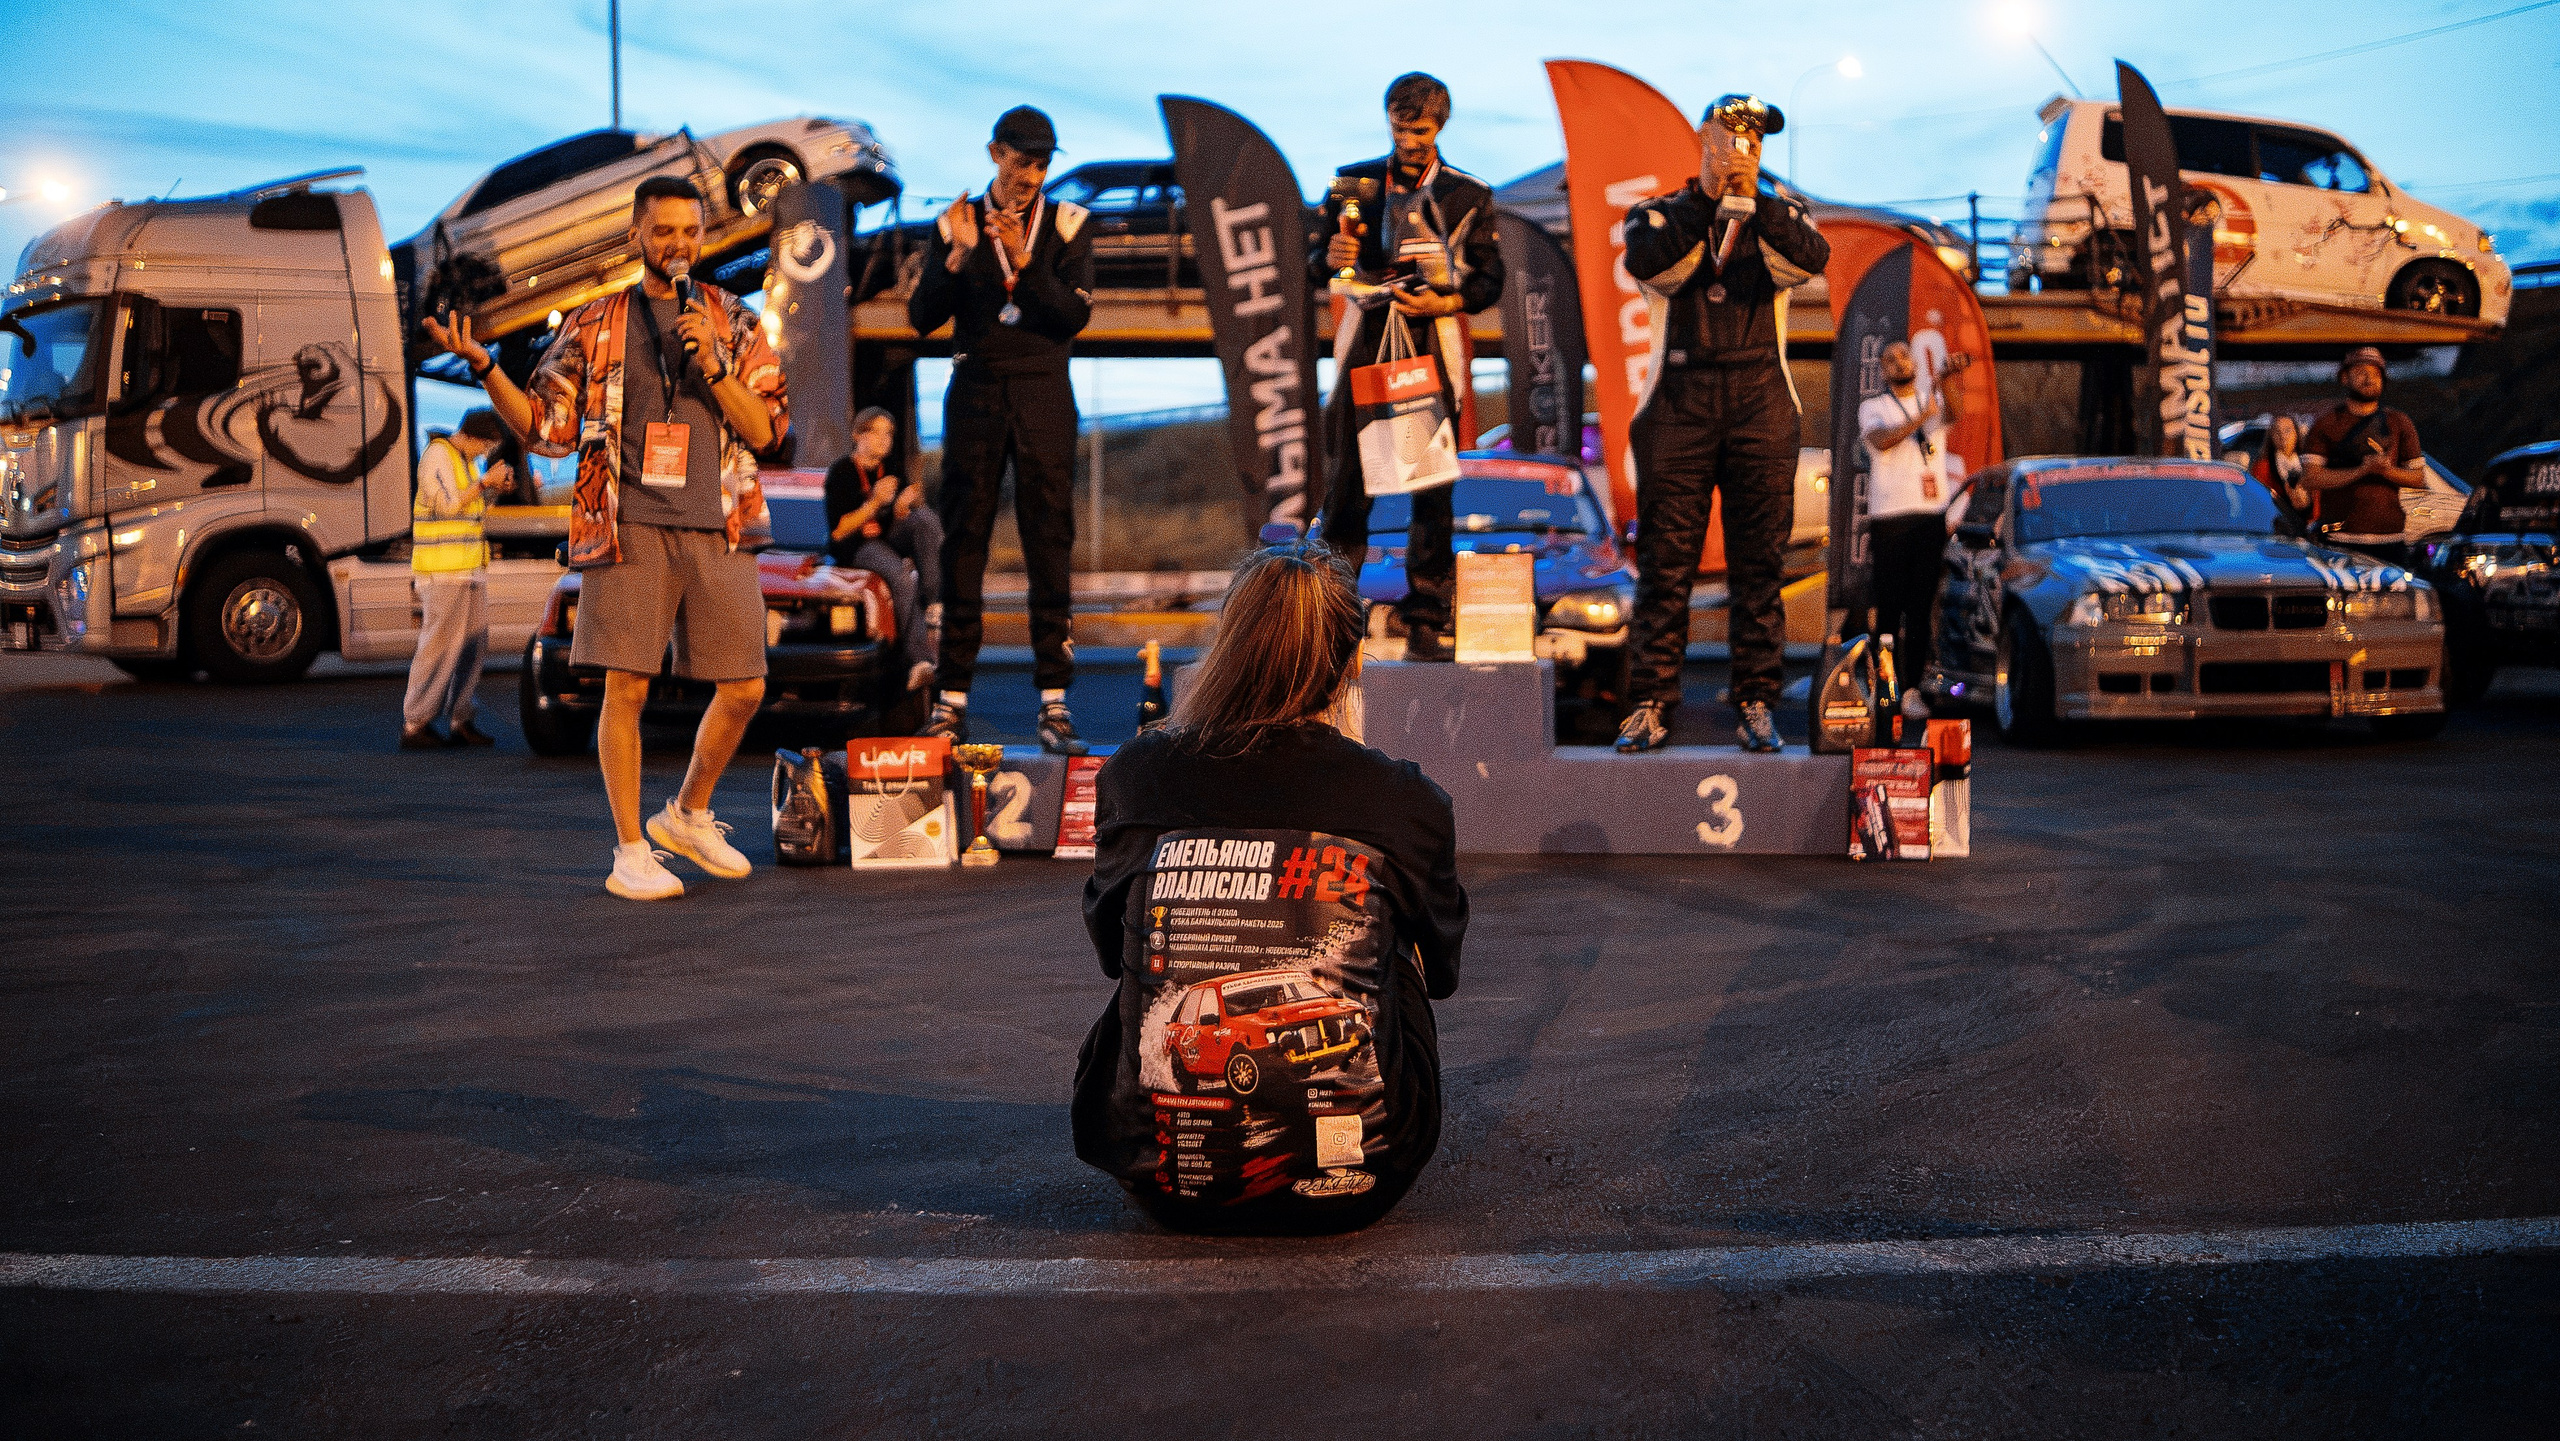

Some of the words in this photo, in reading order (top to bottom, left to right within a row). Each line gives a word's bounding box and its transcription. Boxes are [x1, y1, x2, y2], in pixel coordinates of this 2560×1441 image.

[1210, 197, 1286, 318] НЕТ
[860, 750, 927, 768] LAVR
[986, 770, 1033, 840] 2
[1696, 774, 1744, 848] 3
[1155, 838, 1275, 869] ЕМЕЛЬЯНОВ
[1152, 870, 1273, 901] ВЛАДИСЛАВ
[1277, 844, 1371, 907] #24
[1170, 917, 1190, 926] КУБКА
[1190, 917, 1241, 928] БАРНАУЛЬСКОЙ
[1241, 919, 1267, 928] РАКЕТЫ
[1267, 920, 1285, 929] 2025
[1217, 908, 1238, 917] ЭТАПА
[1215, 961, 1241, 971] РАЗРЯД
